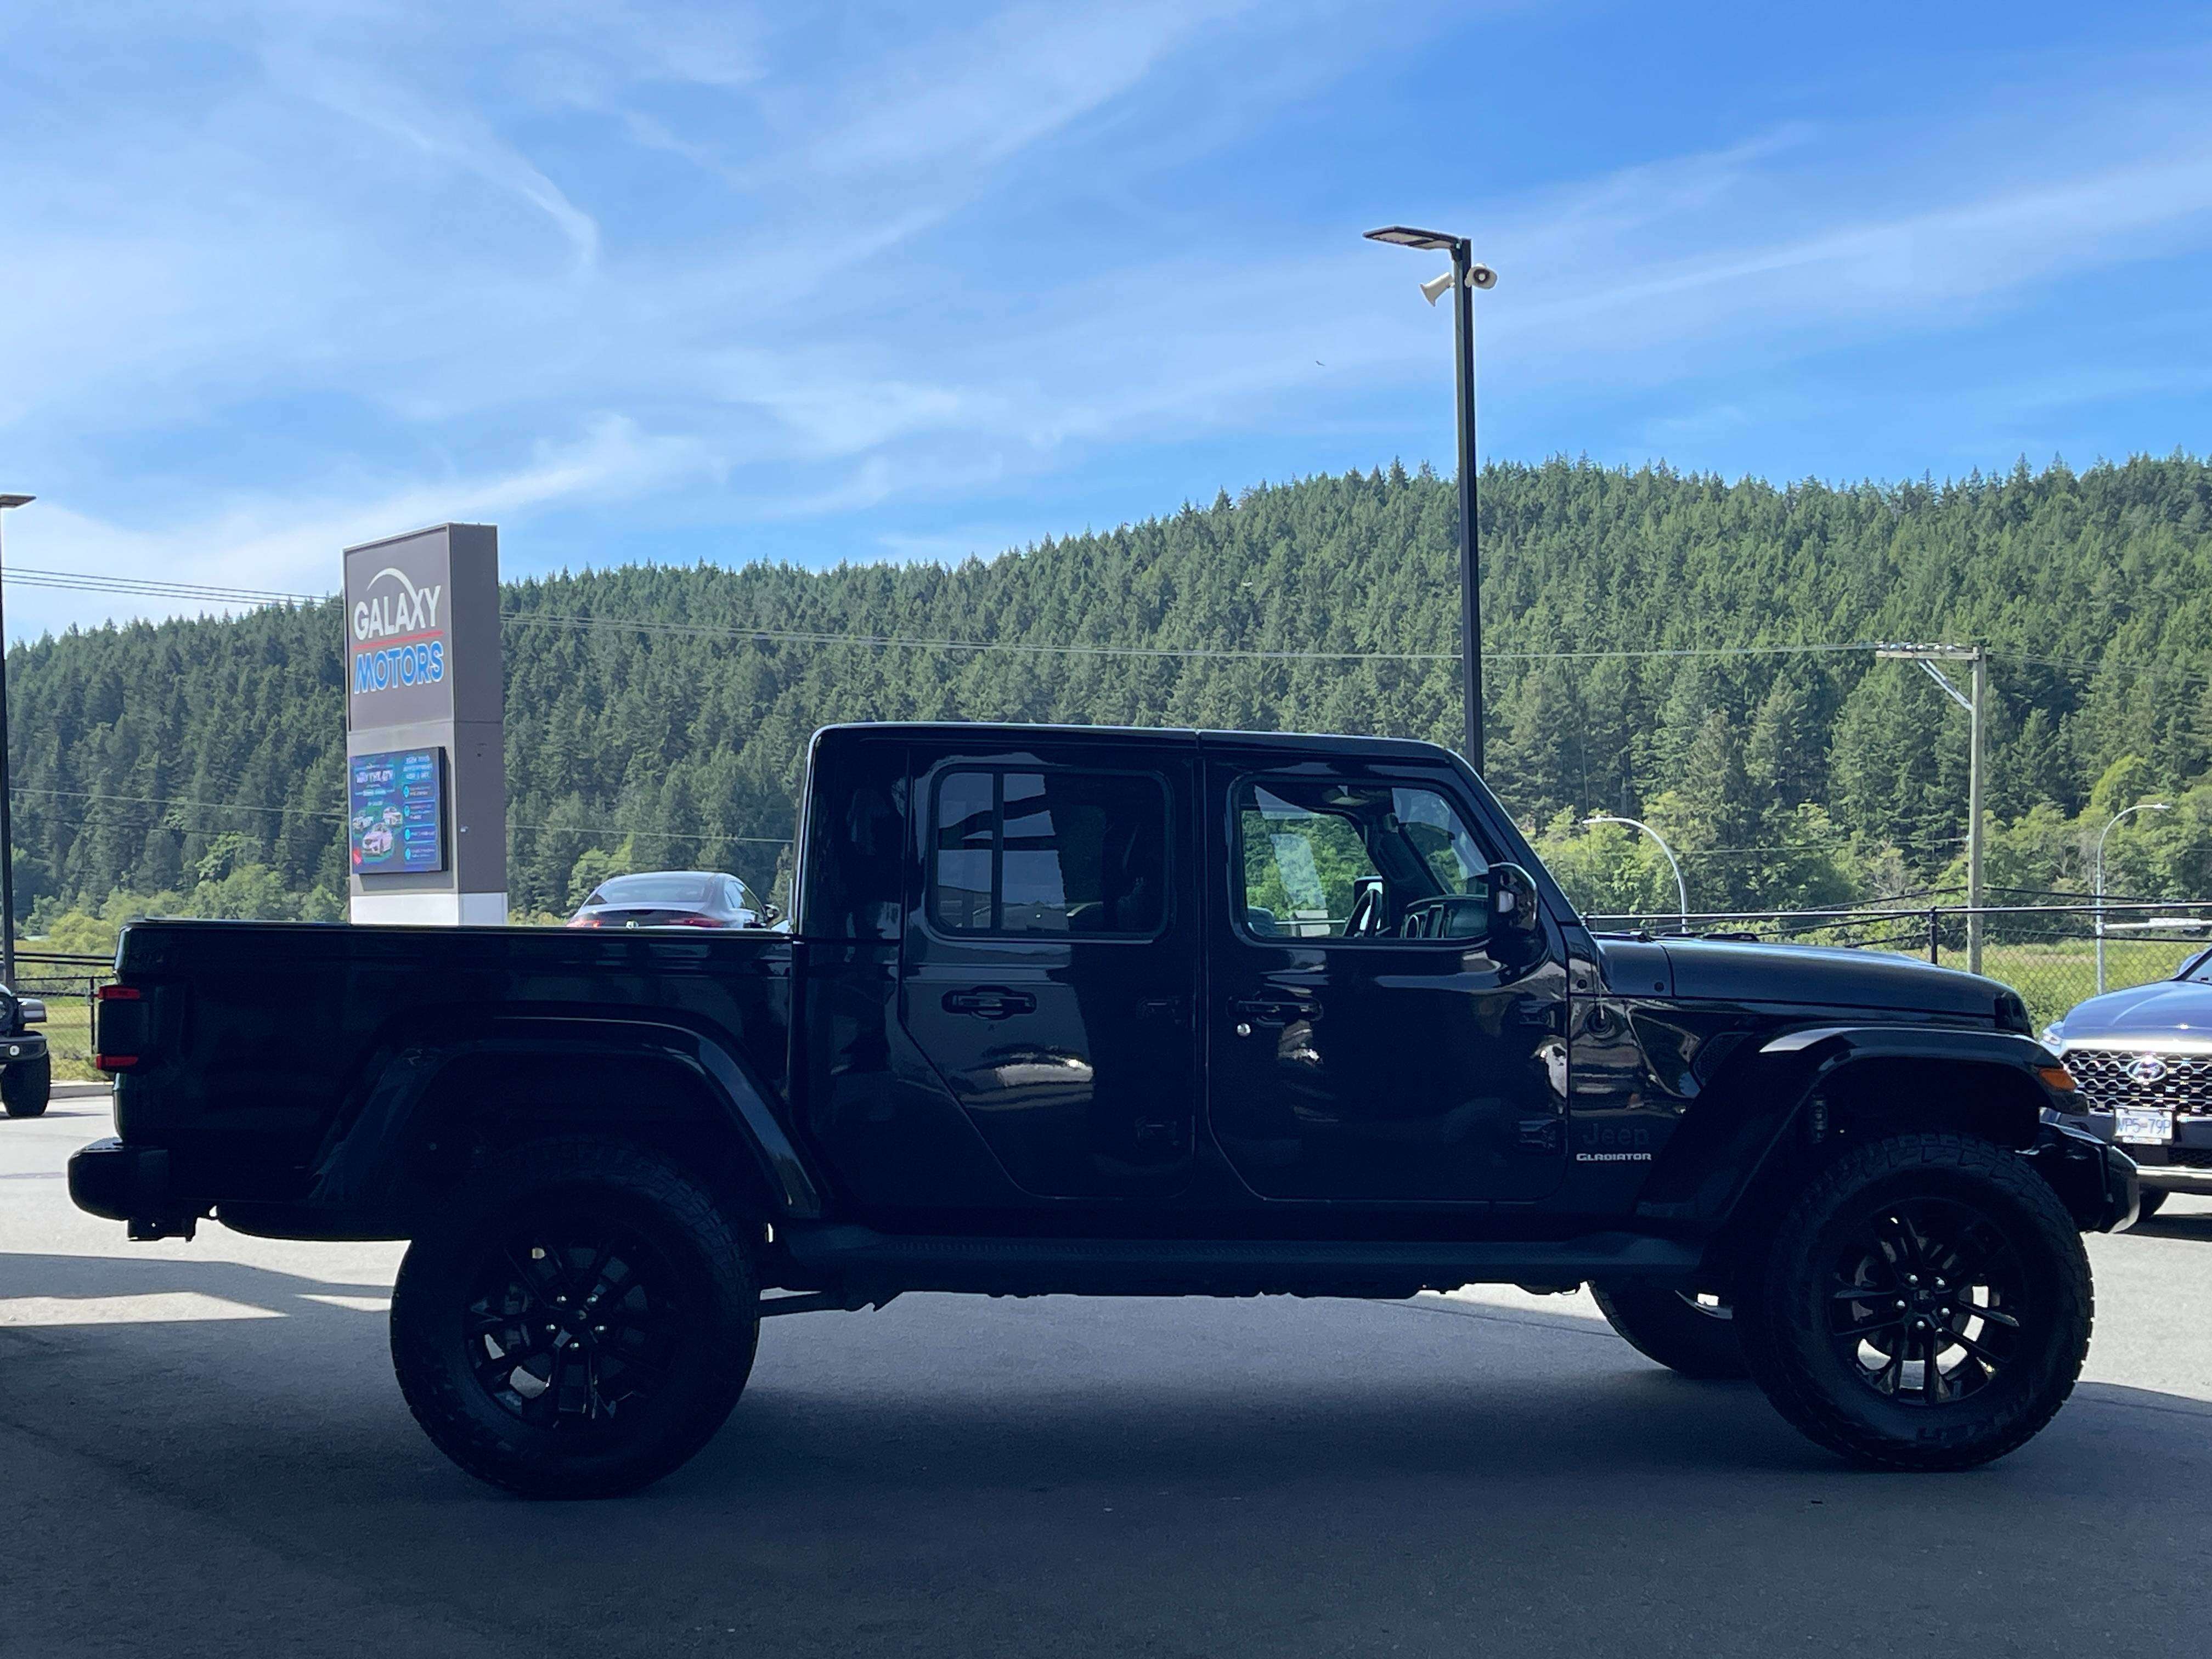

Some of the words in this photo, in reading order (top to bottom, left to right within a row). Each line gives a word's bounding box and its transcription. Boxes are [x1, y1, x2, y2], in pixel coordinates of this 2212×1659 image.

[354, 585, 441, 640] GALAXY
[354, 641, 444, 694] MOTORS
[1583, 1124, 1649, 1147] Jeep
[1576, 1153, 1651, 1161] GLADIATOR
